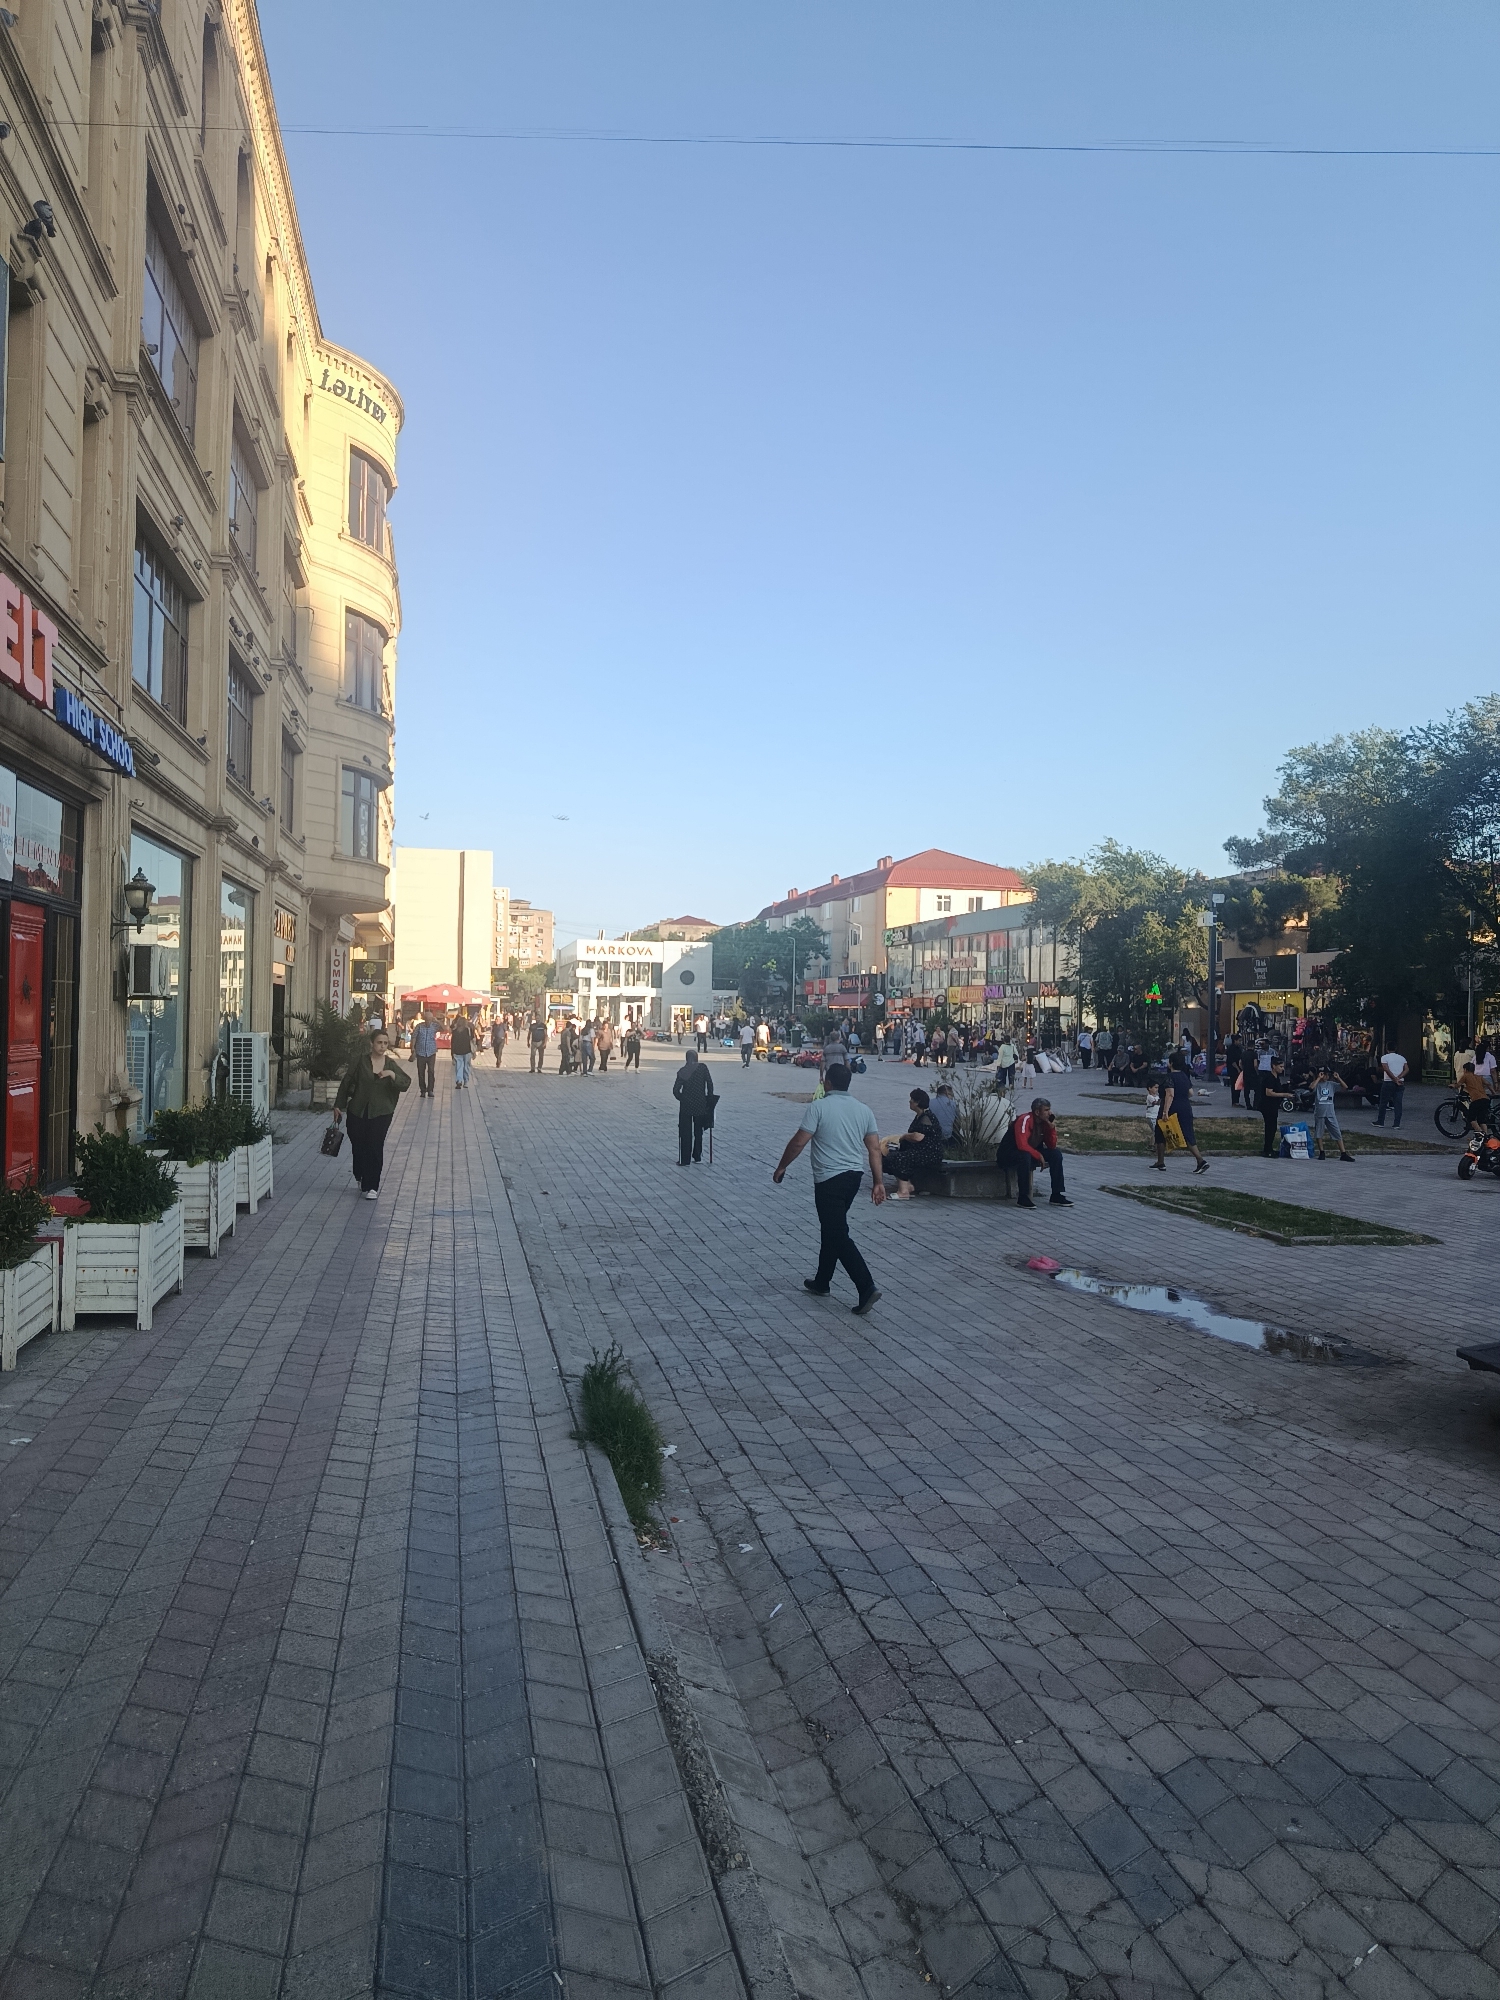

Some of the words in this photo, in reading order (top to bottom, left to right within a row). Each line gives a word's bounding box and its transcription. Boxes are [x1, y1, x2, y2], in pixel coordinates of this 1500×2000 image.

[66, 688, 95, 744] HIGH
[99, 718, 137, 778] SCHOOL
[586, 945, 653, 956] MARKOVA
[361, 983, 377, 991] 24/7
